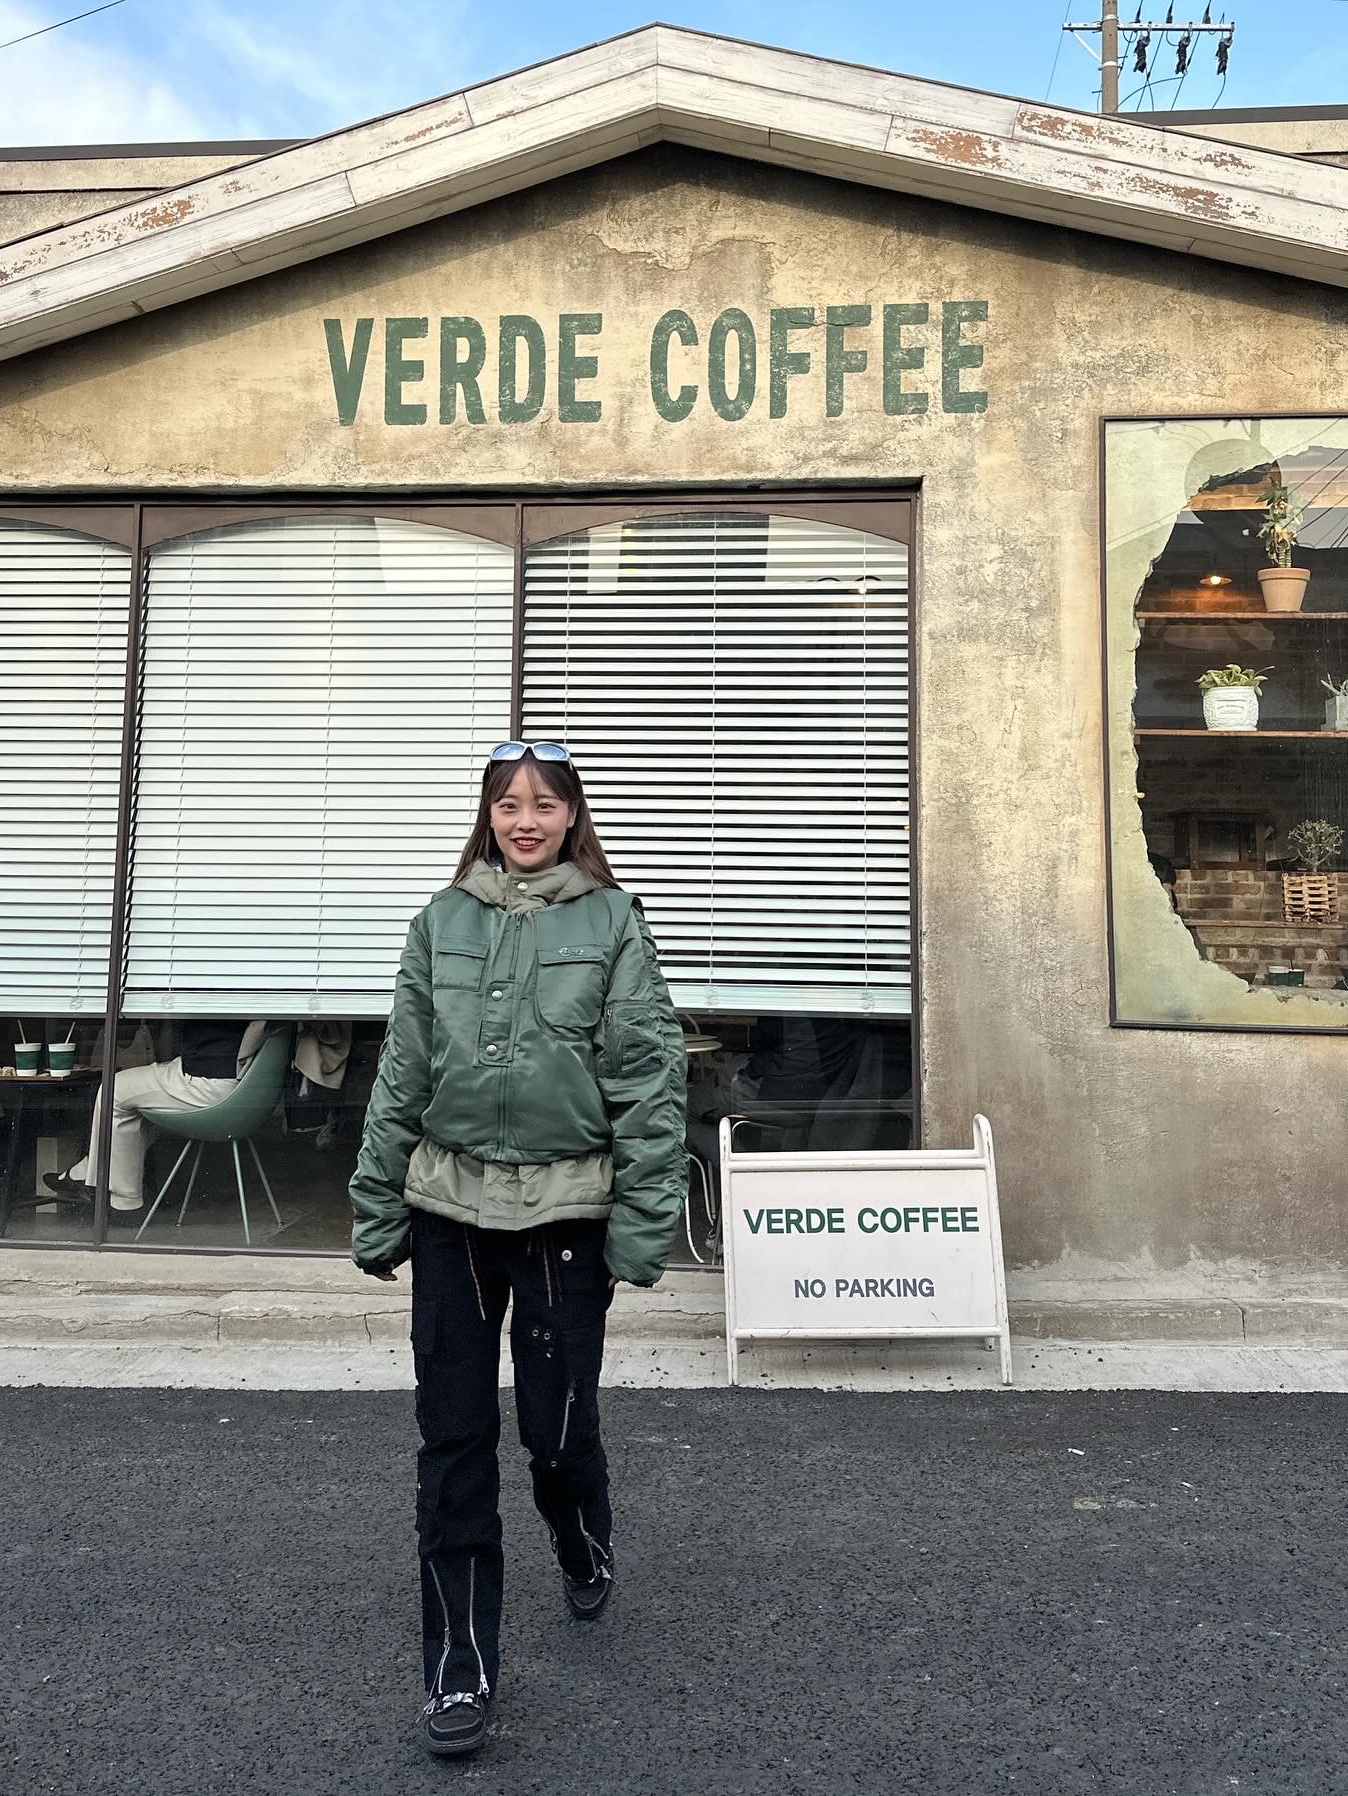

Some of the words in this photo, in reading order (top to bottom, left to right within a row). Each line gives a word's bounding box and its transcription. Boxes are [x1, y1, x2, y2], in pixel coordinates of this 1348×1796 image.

[323, 313, 603, 426] VERDE
[650, 301, 989, 422] COFFEE
[743, 1208, 845, 1234] VERDE
[858, 1207, 980, 1233] COFFEE
[794, 1279, 826, 1298] NO
[835, 1278, 935, 1298] PARKING
